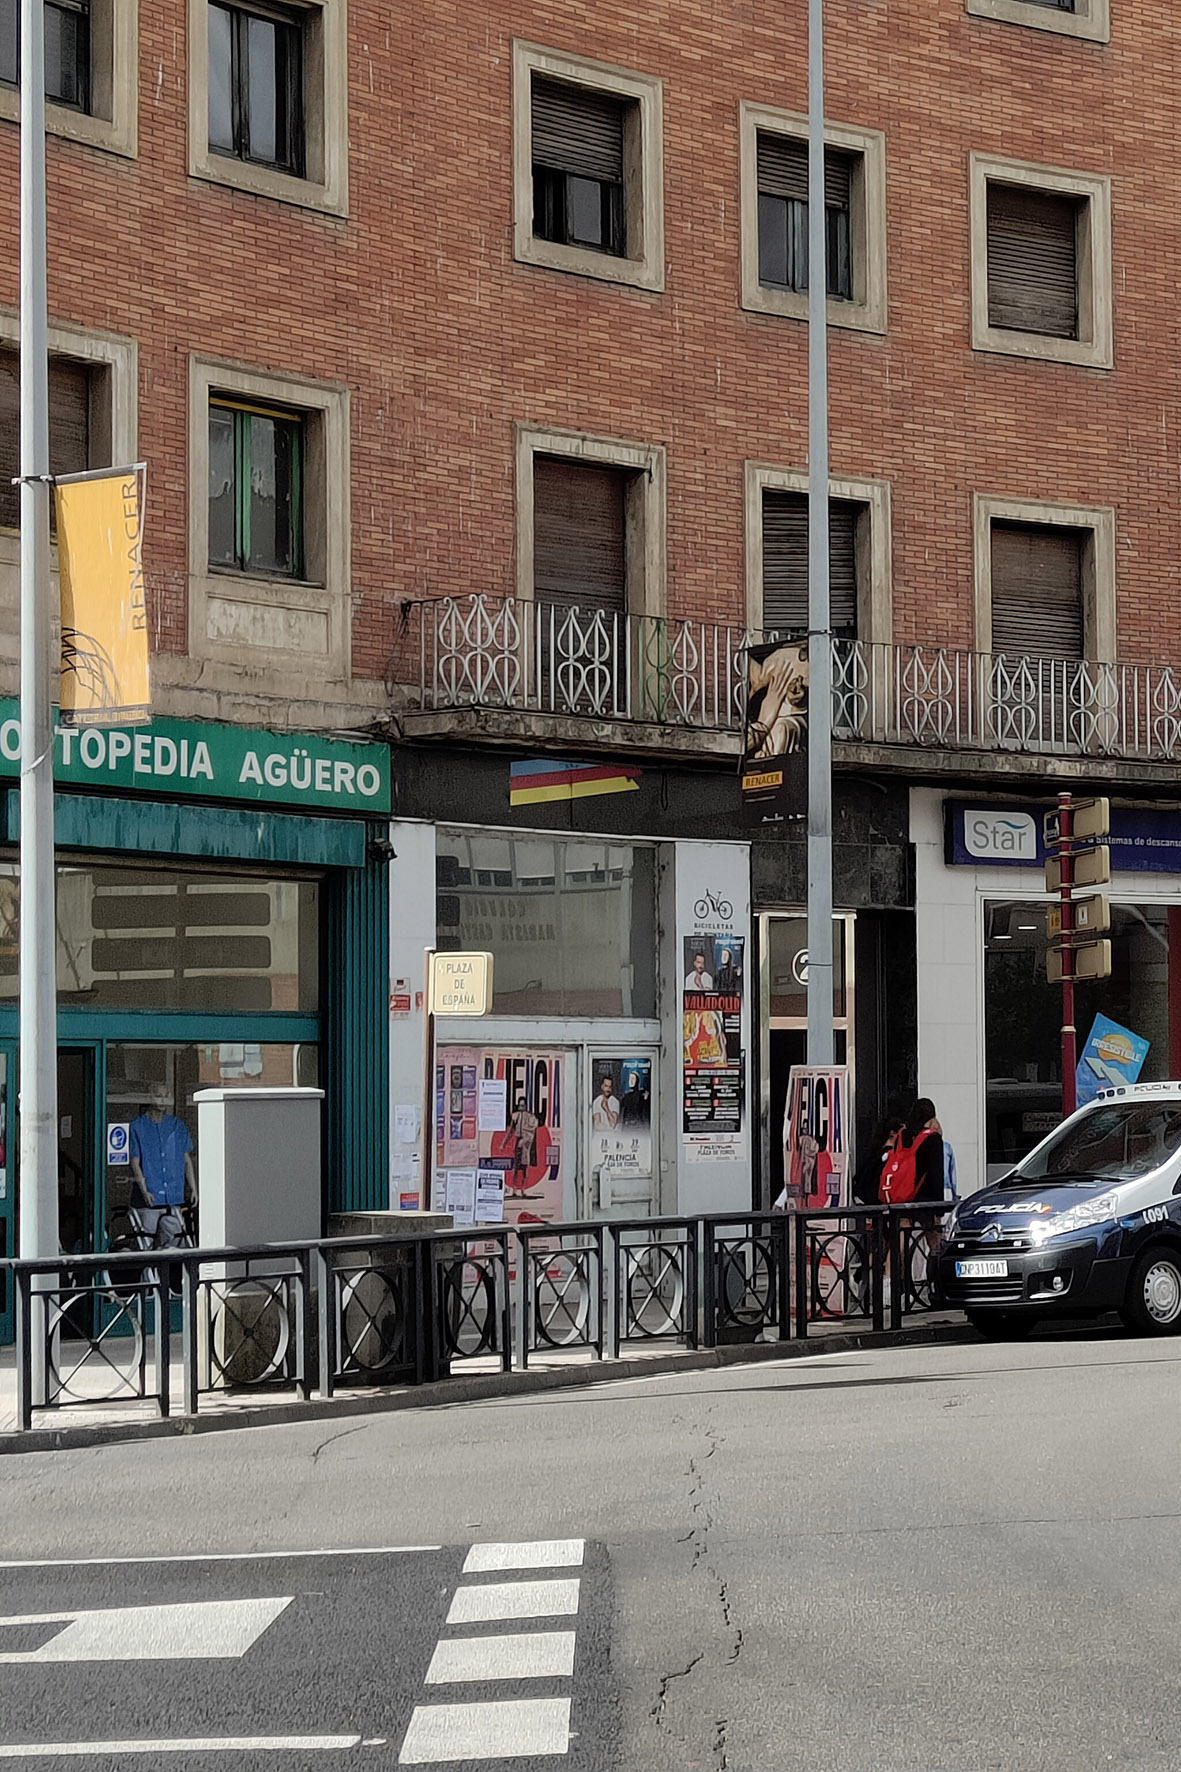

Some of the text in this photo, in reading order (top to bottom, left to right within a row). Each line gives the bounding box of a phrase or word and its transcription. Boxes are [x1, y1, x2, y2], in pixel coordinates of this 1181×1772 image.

[121, 482, 147, 631] RENACER
[0, 719, 381, 797] OTOPEDIA AGÜERO
[745, 773, 780, 788] RENACER
[973, 820, 1028, 851] Star
[1134, 837, 1144, 847] de
[694, 922, 733, 930] BICICLETAS
[446, 963, 472, 973] PLAZA
[454, 979, 464, 989] DE
[442, 992, 475, 1005] ESPAÑA
[684, 996, 740, 1010] VALLADOLID
